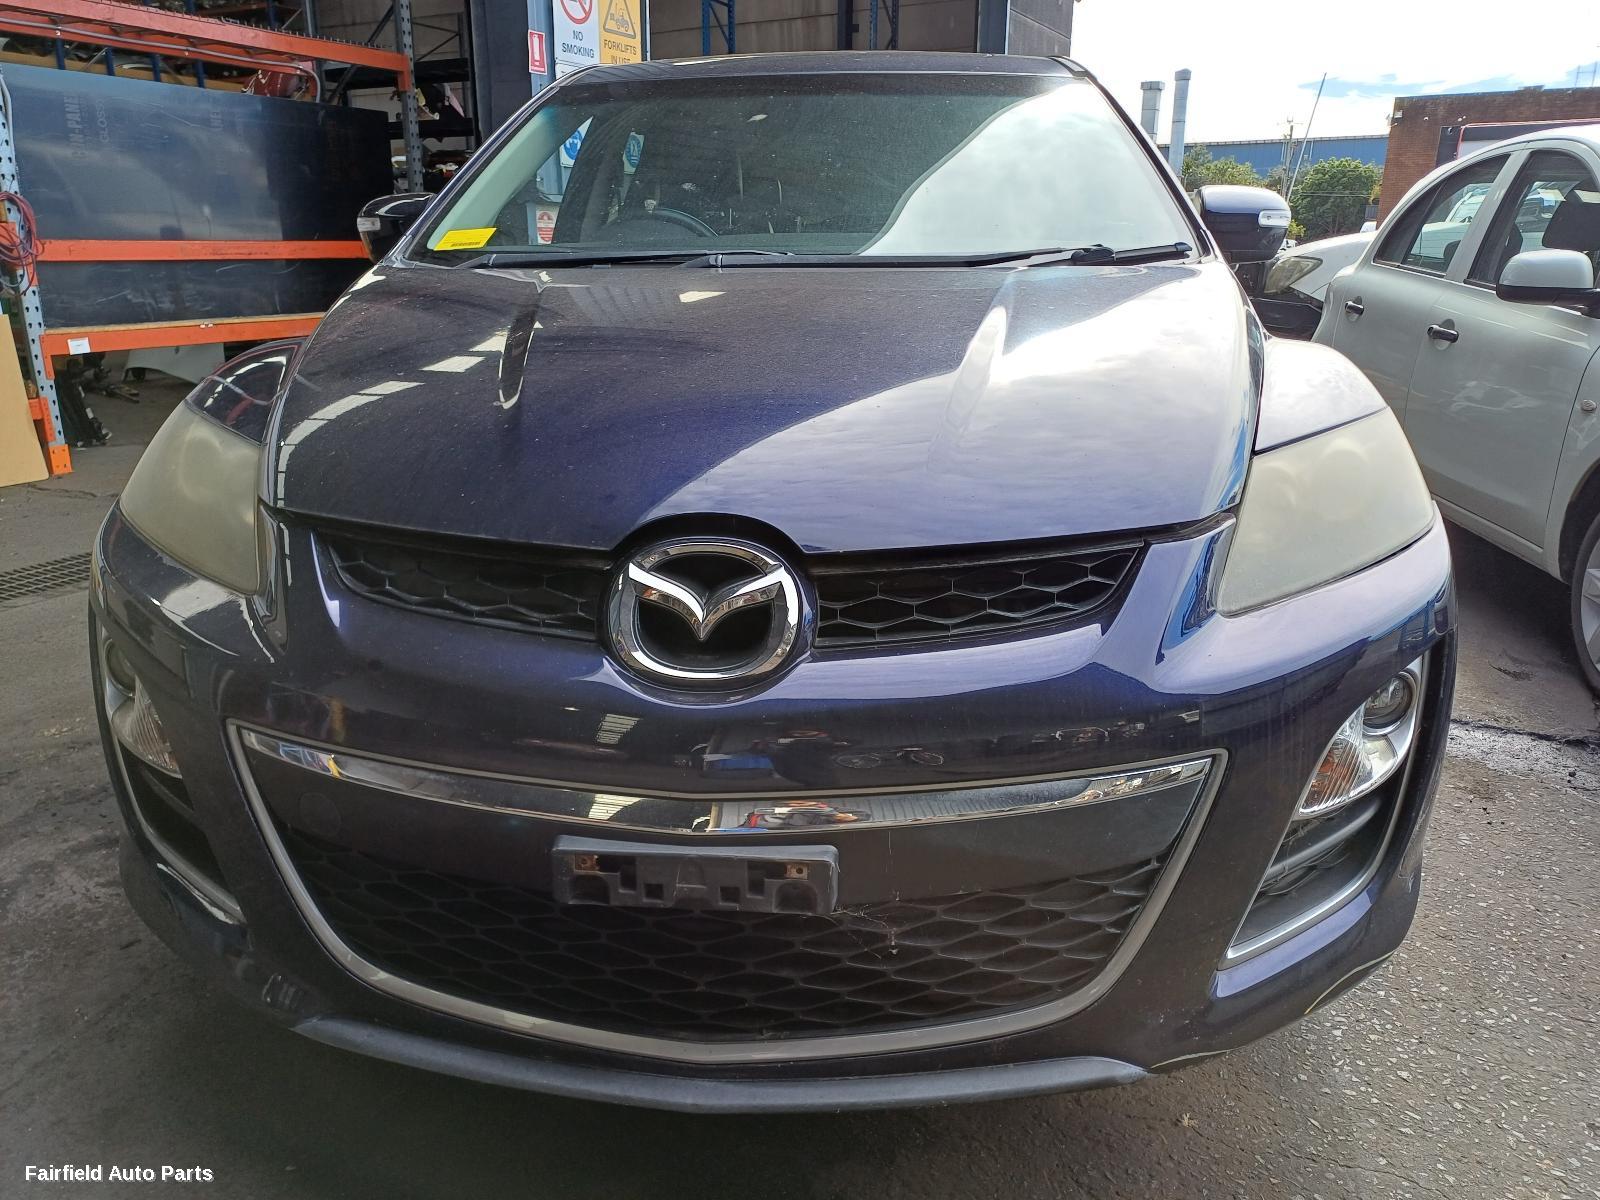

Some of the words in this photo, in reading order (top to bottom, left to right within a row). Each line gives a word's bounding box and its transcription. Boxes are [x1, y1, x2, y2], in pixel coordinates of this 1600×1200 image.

[573, 30, 584, 41] NO
[562, 42, 595, 58] SMOKING
[603, 39, 637, 55] FORKLIFTS
